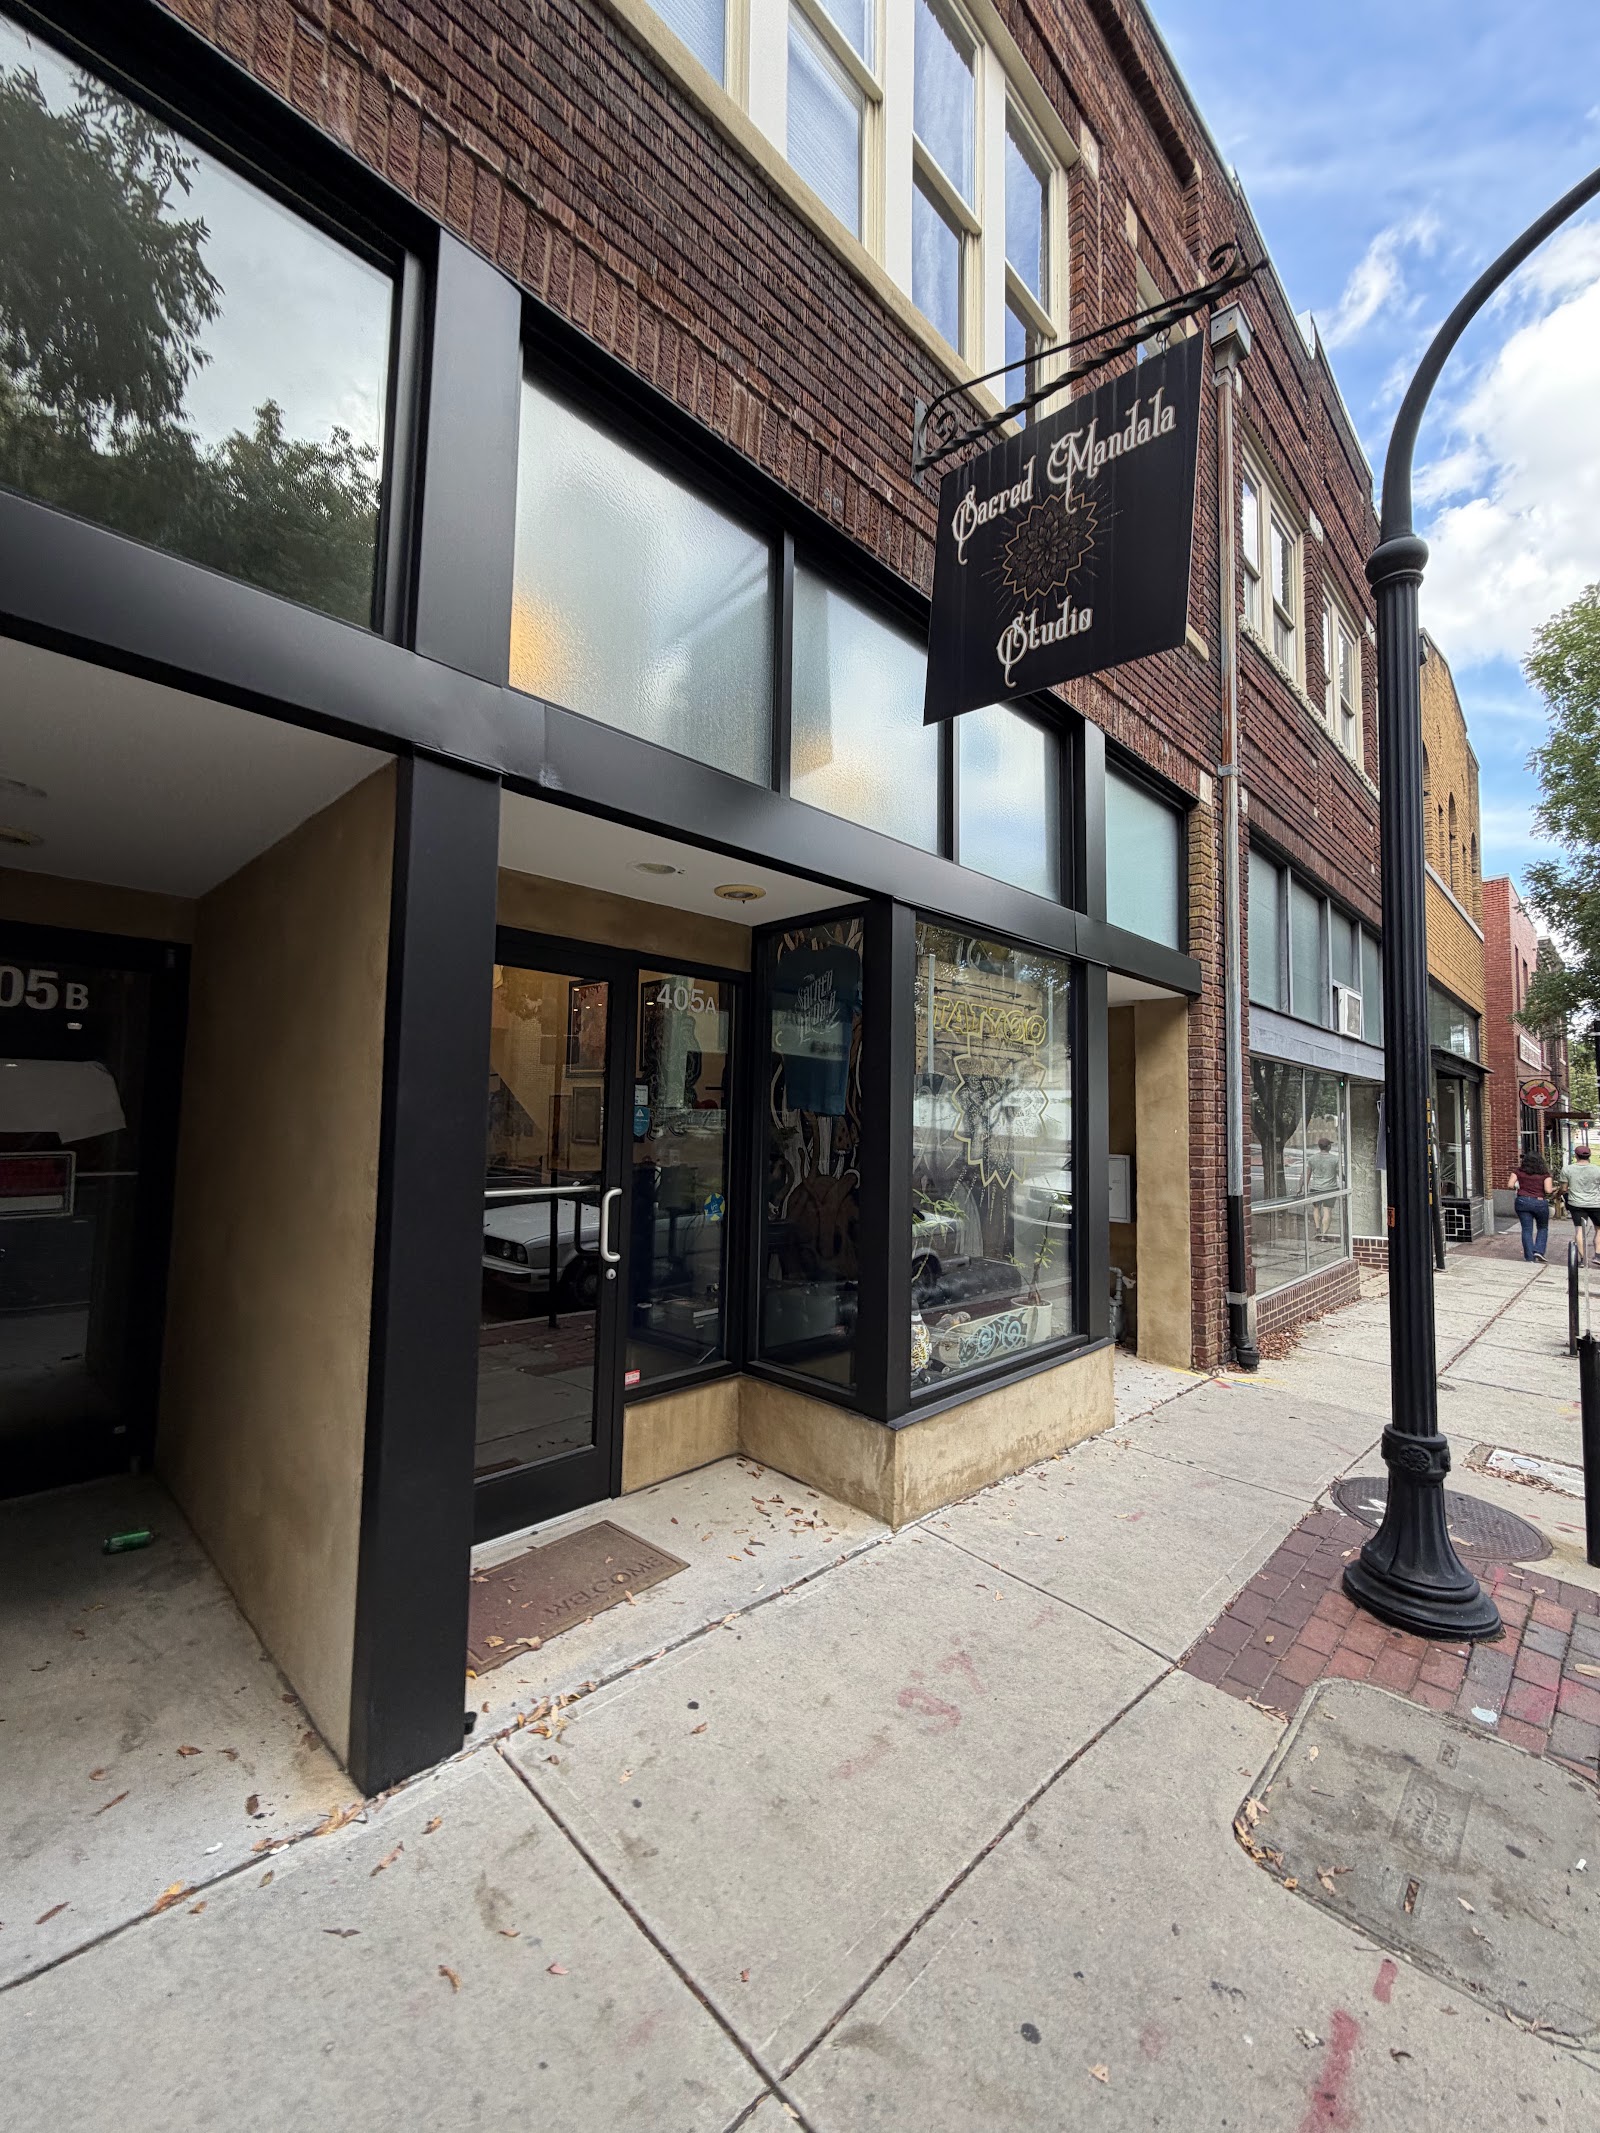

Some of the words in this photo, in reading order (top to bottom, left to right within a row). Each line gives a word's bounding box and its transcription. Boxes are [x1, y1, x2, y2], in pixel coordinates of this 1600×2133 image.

[951, 454, 1036, 566] Sacred
[1046, 386, 1177, 514] Mandala
[996, 595, 1093, 688] Studio
[656, 983, 717, 1015] 405A
[933, 995, 1047, 1046] TATTOO
[545, 1555, 664, 1617] WELCOME
